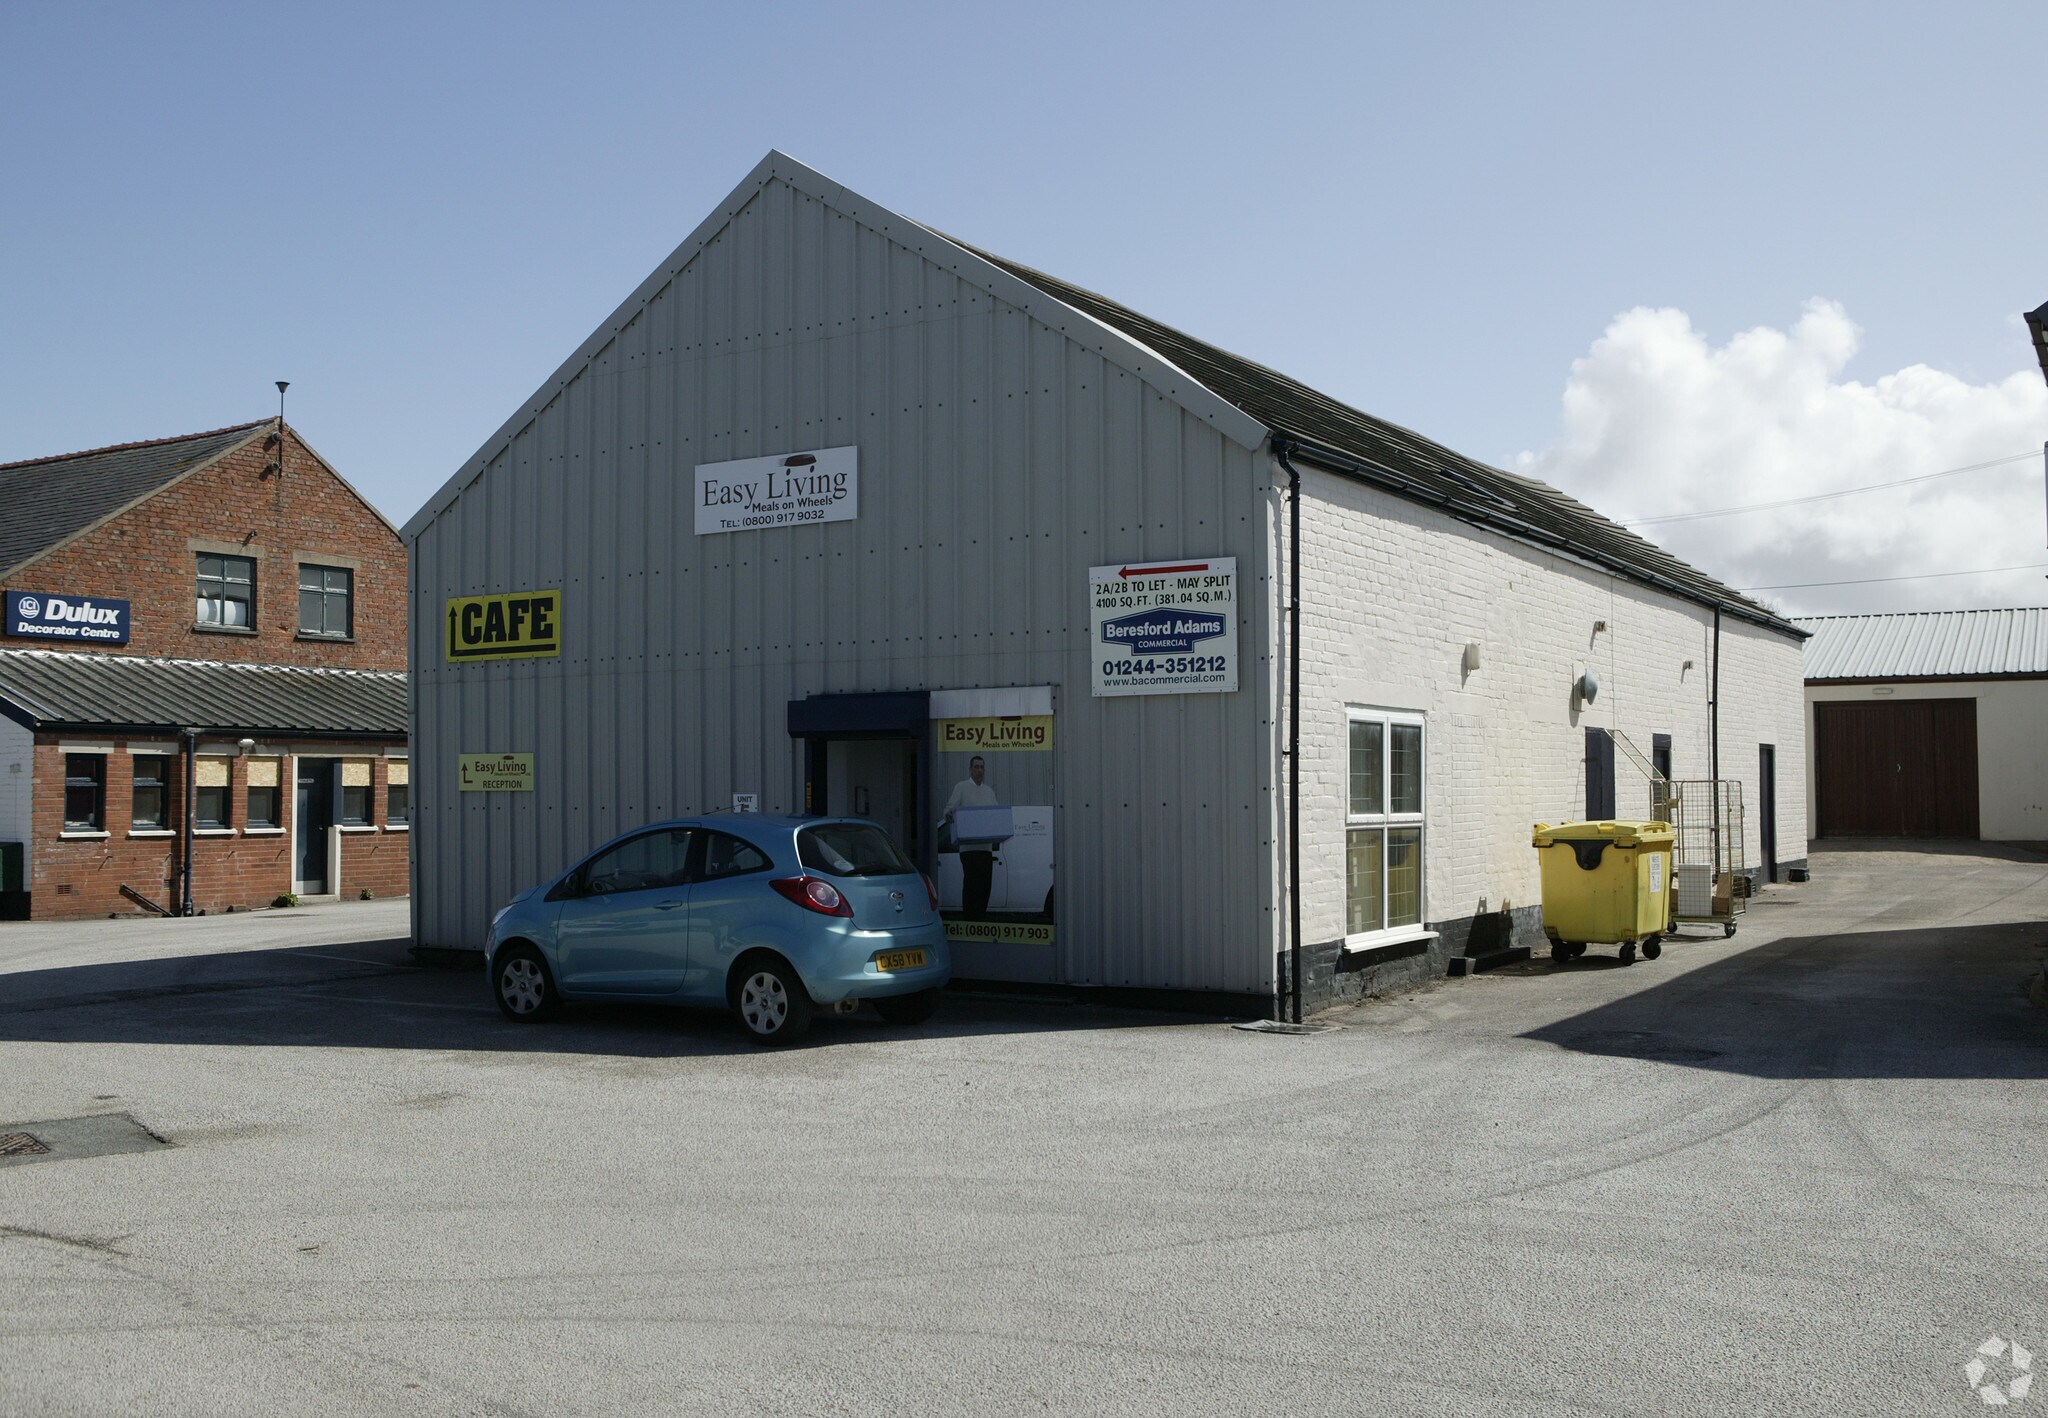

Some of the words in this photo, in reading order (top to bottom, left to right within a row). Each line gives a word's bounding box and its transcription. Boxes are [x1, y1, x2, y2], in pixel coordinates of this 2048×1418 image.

[702, 479, 758, 509] Easy
[766, 465, 848, 500] Living
[752, 501, 780, 513] Meals
[782, 501, 794, 510] on
[797, 495, 833, 507] Wheels
[742, 514, 775, 527] (0800)
[777, 512, 795, 523] 917
[797, 510, 825, 521] 9032
[1096, 582, 1128, 596] 2A/2B
[1132, 581, 1145, 593] TO
[1148, 579, 1166, 591] LET
[1177, 577, 1200, 590] MAY
[1203, 575, 1231, 588] SPLIT
[22, 600, 36, 610] ICI
[1096, 598, 1117, 609] 4100
[45, 599, 120, 625] Dulux
[462, 597, 553, 645] CAFE
[1106, 621, 1171, 638] Beresford
[1174, 619, 1221, 634] Adams
[18, 622, 79, 635] Decorator
[80, 626, 120, 638] Centre
[1138, 639, 1188, 649] COMMERCIAL
[1102, 655, 1226, 676] 01244-351212
[1103, 674, 1225, 687] www.bacommercial.com
[945, 724, 985, 745] Easy
[990, 722, 1045, 744] Living
[475, 761, 495, 774] Easy
[498, 761, 526, 774] Living
[483, 780, 522, 789] RECEPTION
[944, 925, 963, 936] Tel:
[965, 925, 1001, 939] (0800)
[1004, 926, 1024, 938] 917
[1028, 928, 1049, 939] 903
[879, 953, 905, 969] CX58
